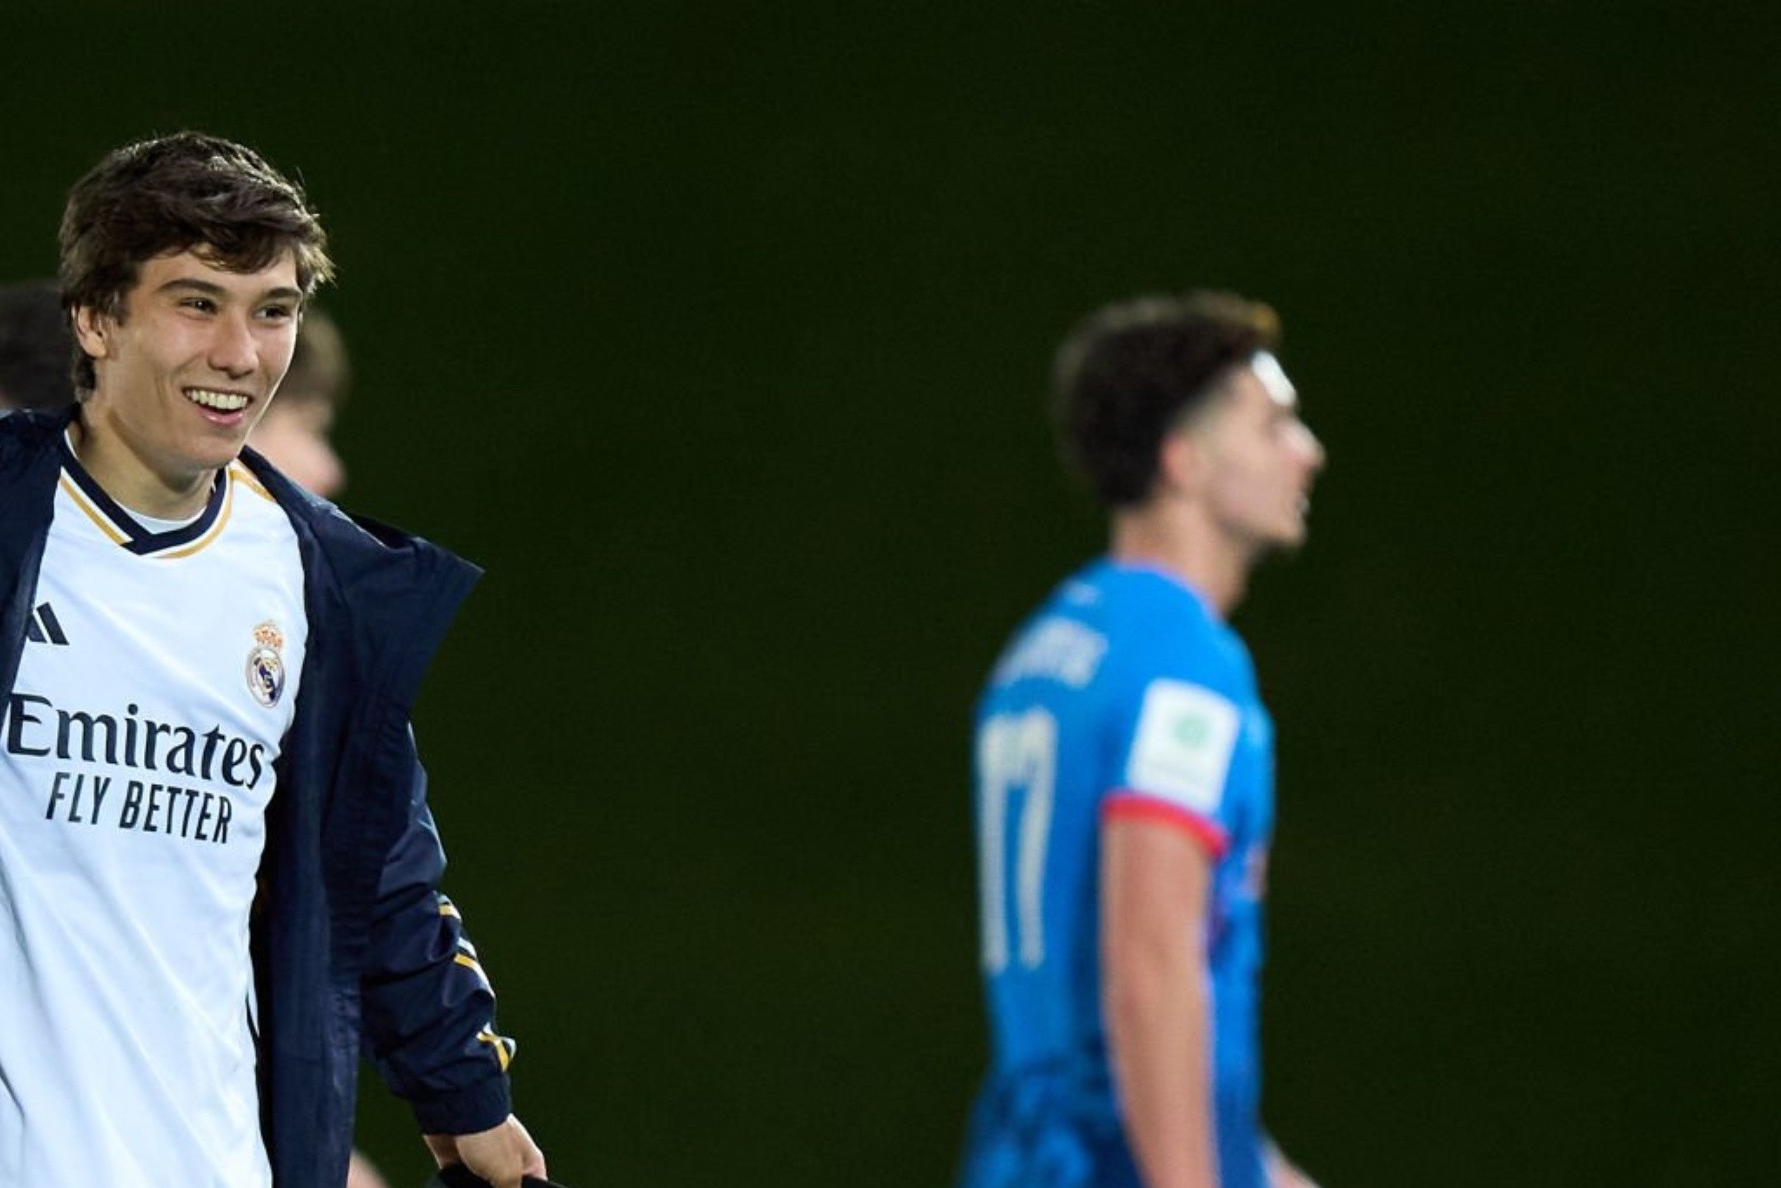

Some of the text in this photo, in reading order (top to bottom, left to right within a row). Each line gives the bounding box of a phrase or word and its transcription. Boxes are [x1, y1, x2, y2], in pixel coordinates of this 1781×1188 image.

[6, 692, 266, 791] Emirates
[45, 771, 233, 845] FLY BETTER
[979, 705, 1057, 976] 17
